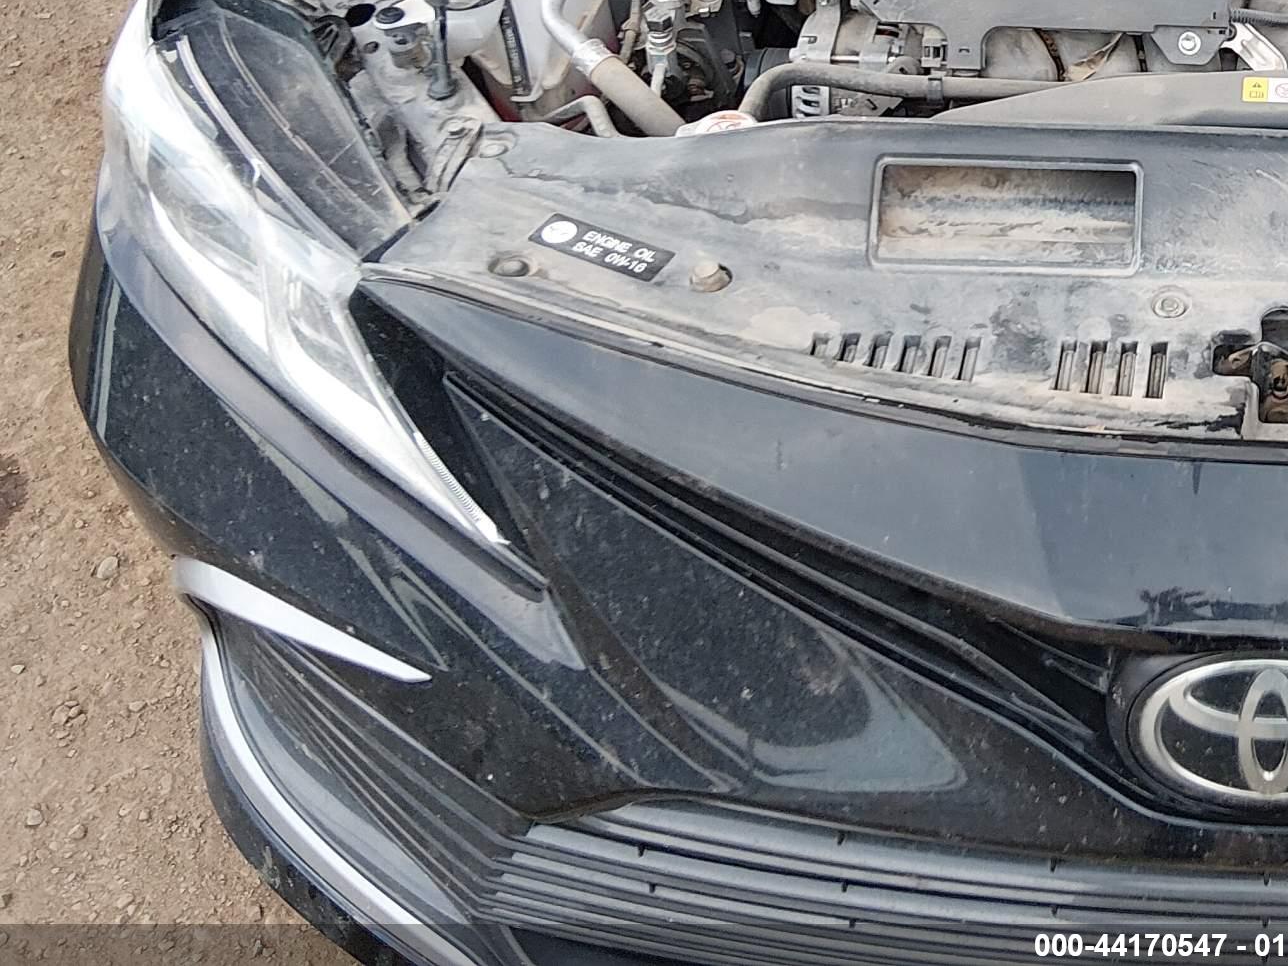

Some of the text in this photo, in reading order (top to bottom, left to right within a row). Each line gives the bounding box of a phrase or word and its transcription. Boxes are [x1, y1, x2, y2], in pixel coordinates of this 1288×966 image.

[571, 241, 604, 258] SAE
[582, 230, 657, 263] ENGINE OIL
